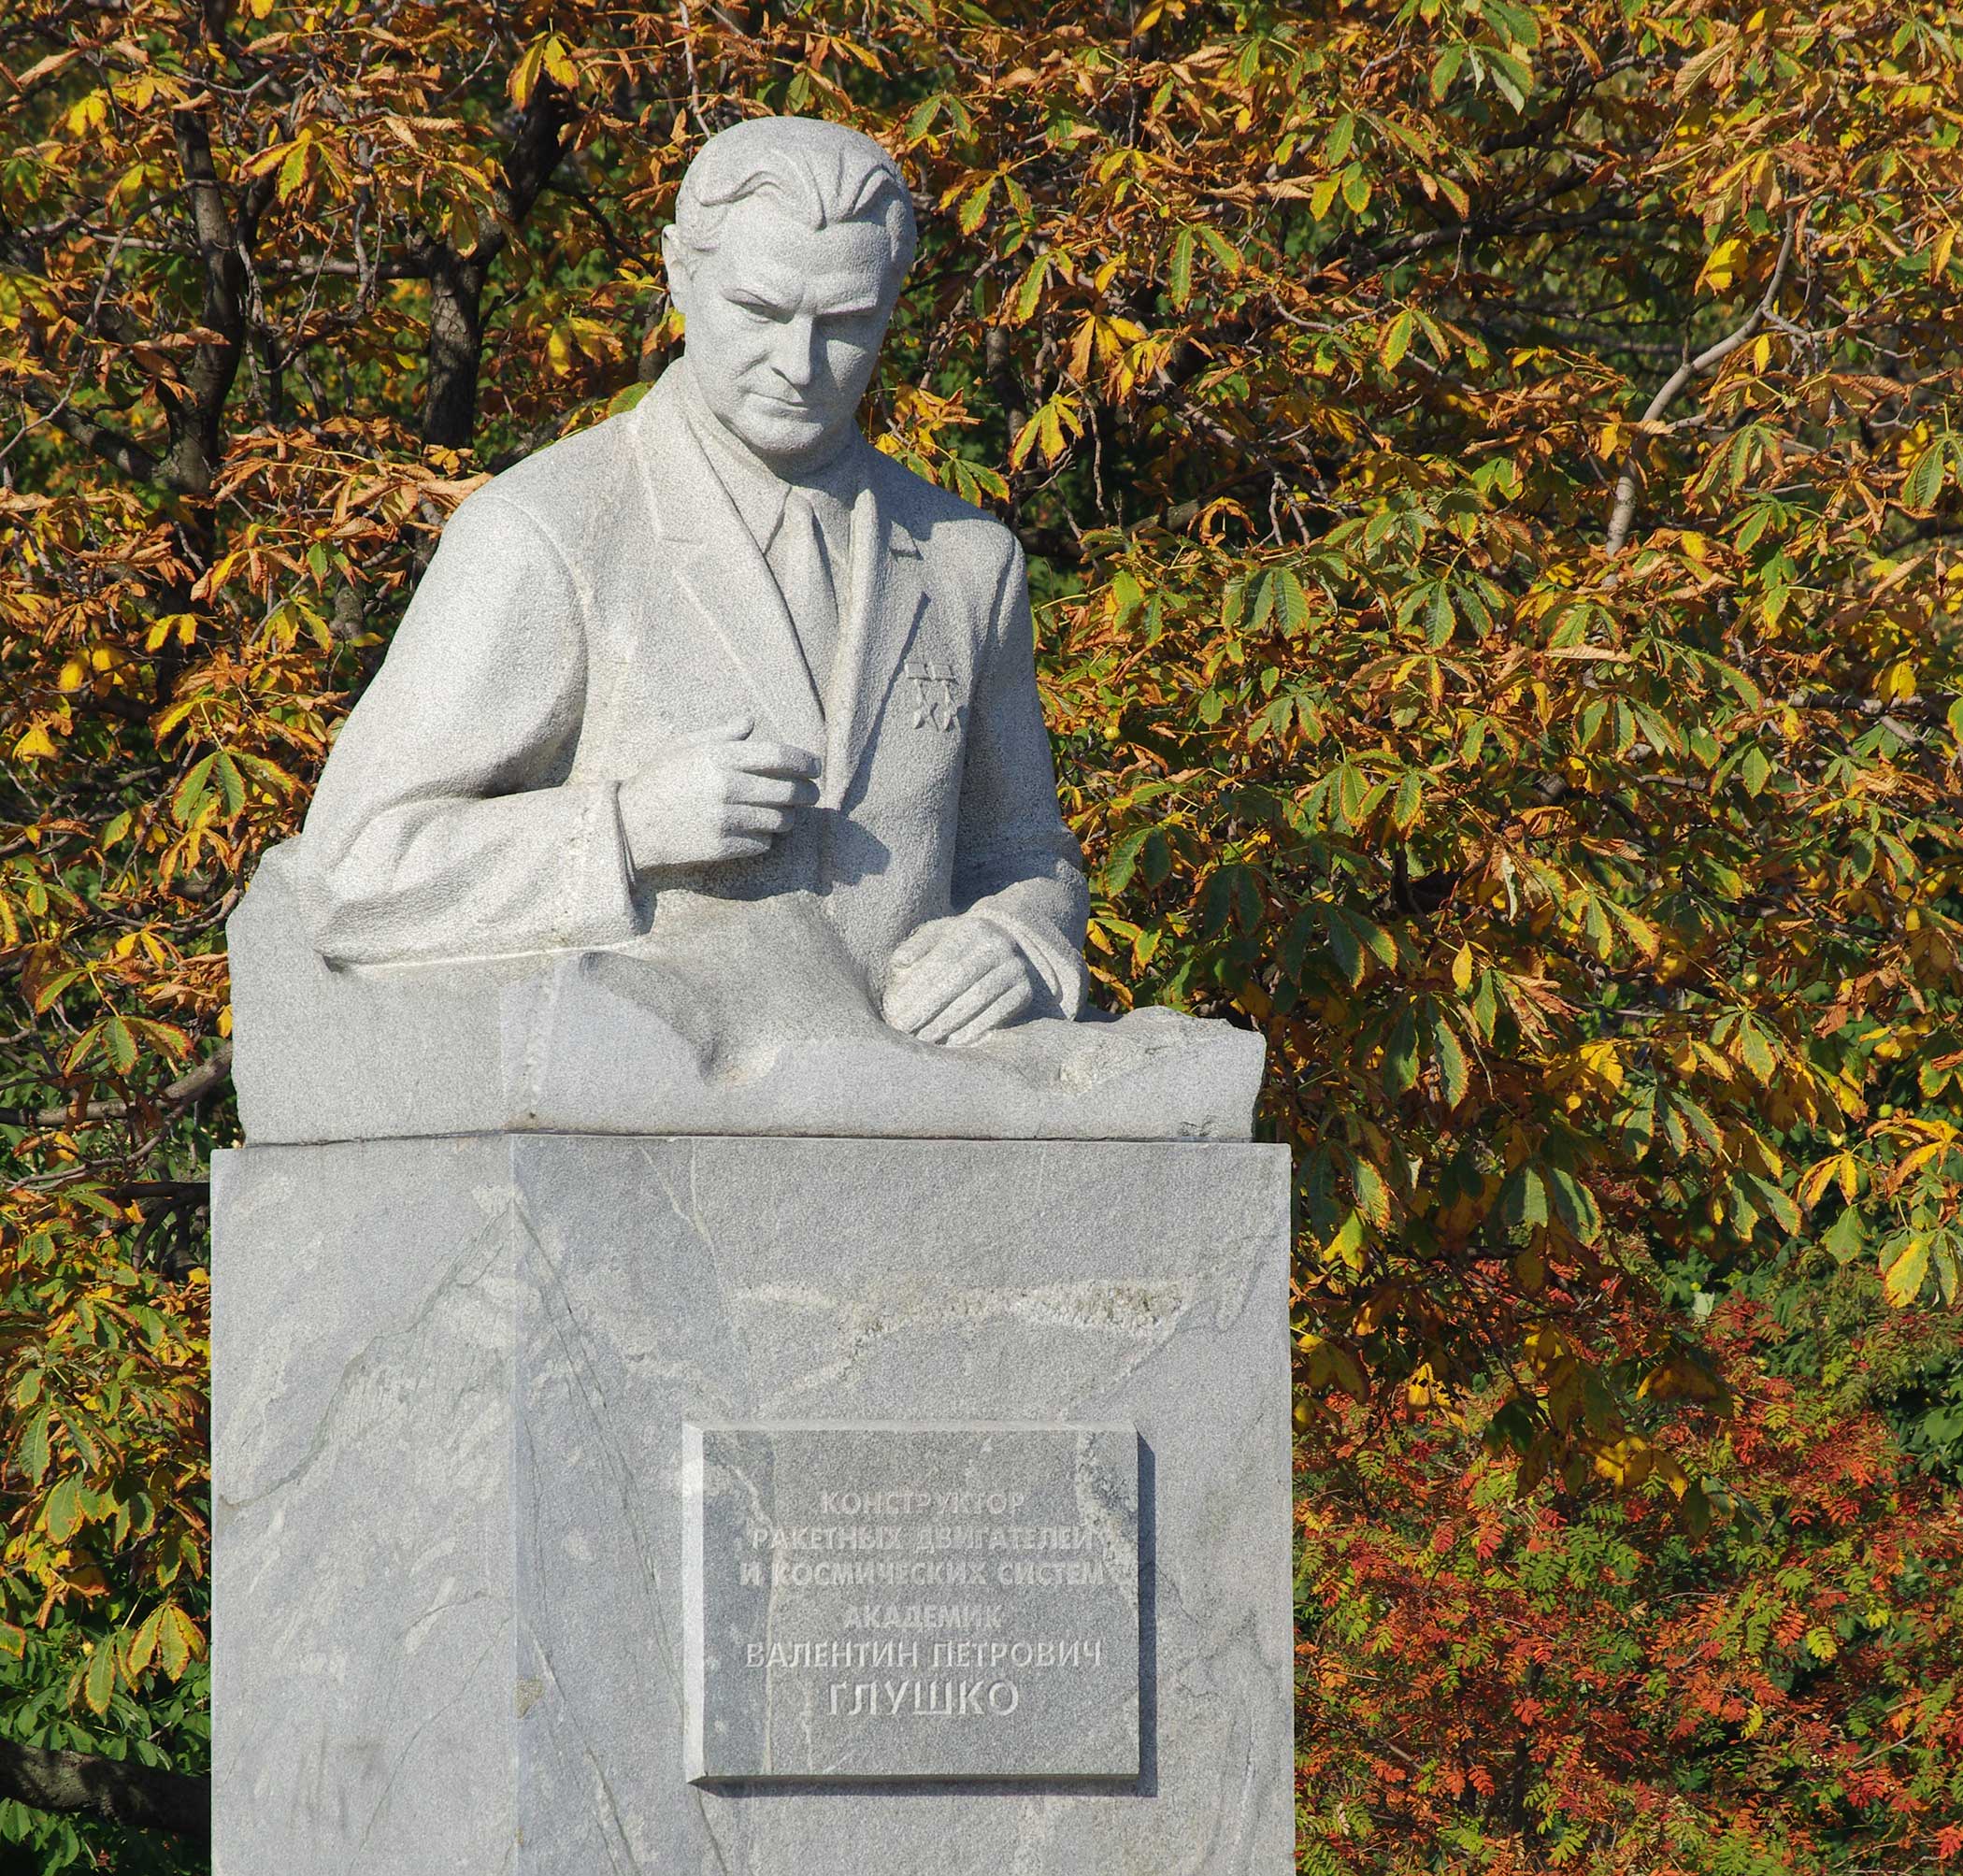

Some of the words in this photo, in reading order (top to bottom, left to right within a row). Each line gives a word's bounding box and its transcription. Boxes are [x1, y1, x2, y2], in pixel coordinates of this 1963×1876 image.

[819, 1490, 1025, 1515] КОНСТРУКТОР
[751, 1525, 901, 1551] РАКЕТНЫХ
[913, 1521, 1093, 1553] ДВИГАТЕЛЕЙ
[739, 1562, 763, 1586] И
[772, 1561, 987, 1587] КОСМИЧЕСКИХ
[996, 1560, 1105, 1586] СИСТЕМ
[842, 1603, 1003, 1633] АКАДЕМИК
[745, 1640, 919, 1668] ВАЛЕНТИН
[930, 1638, 1104, 1668] ПЕТРОВИЧ
[828, 1679, 1021, 1716] ГЛУШКО
